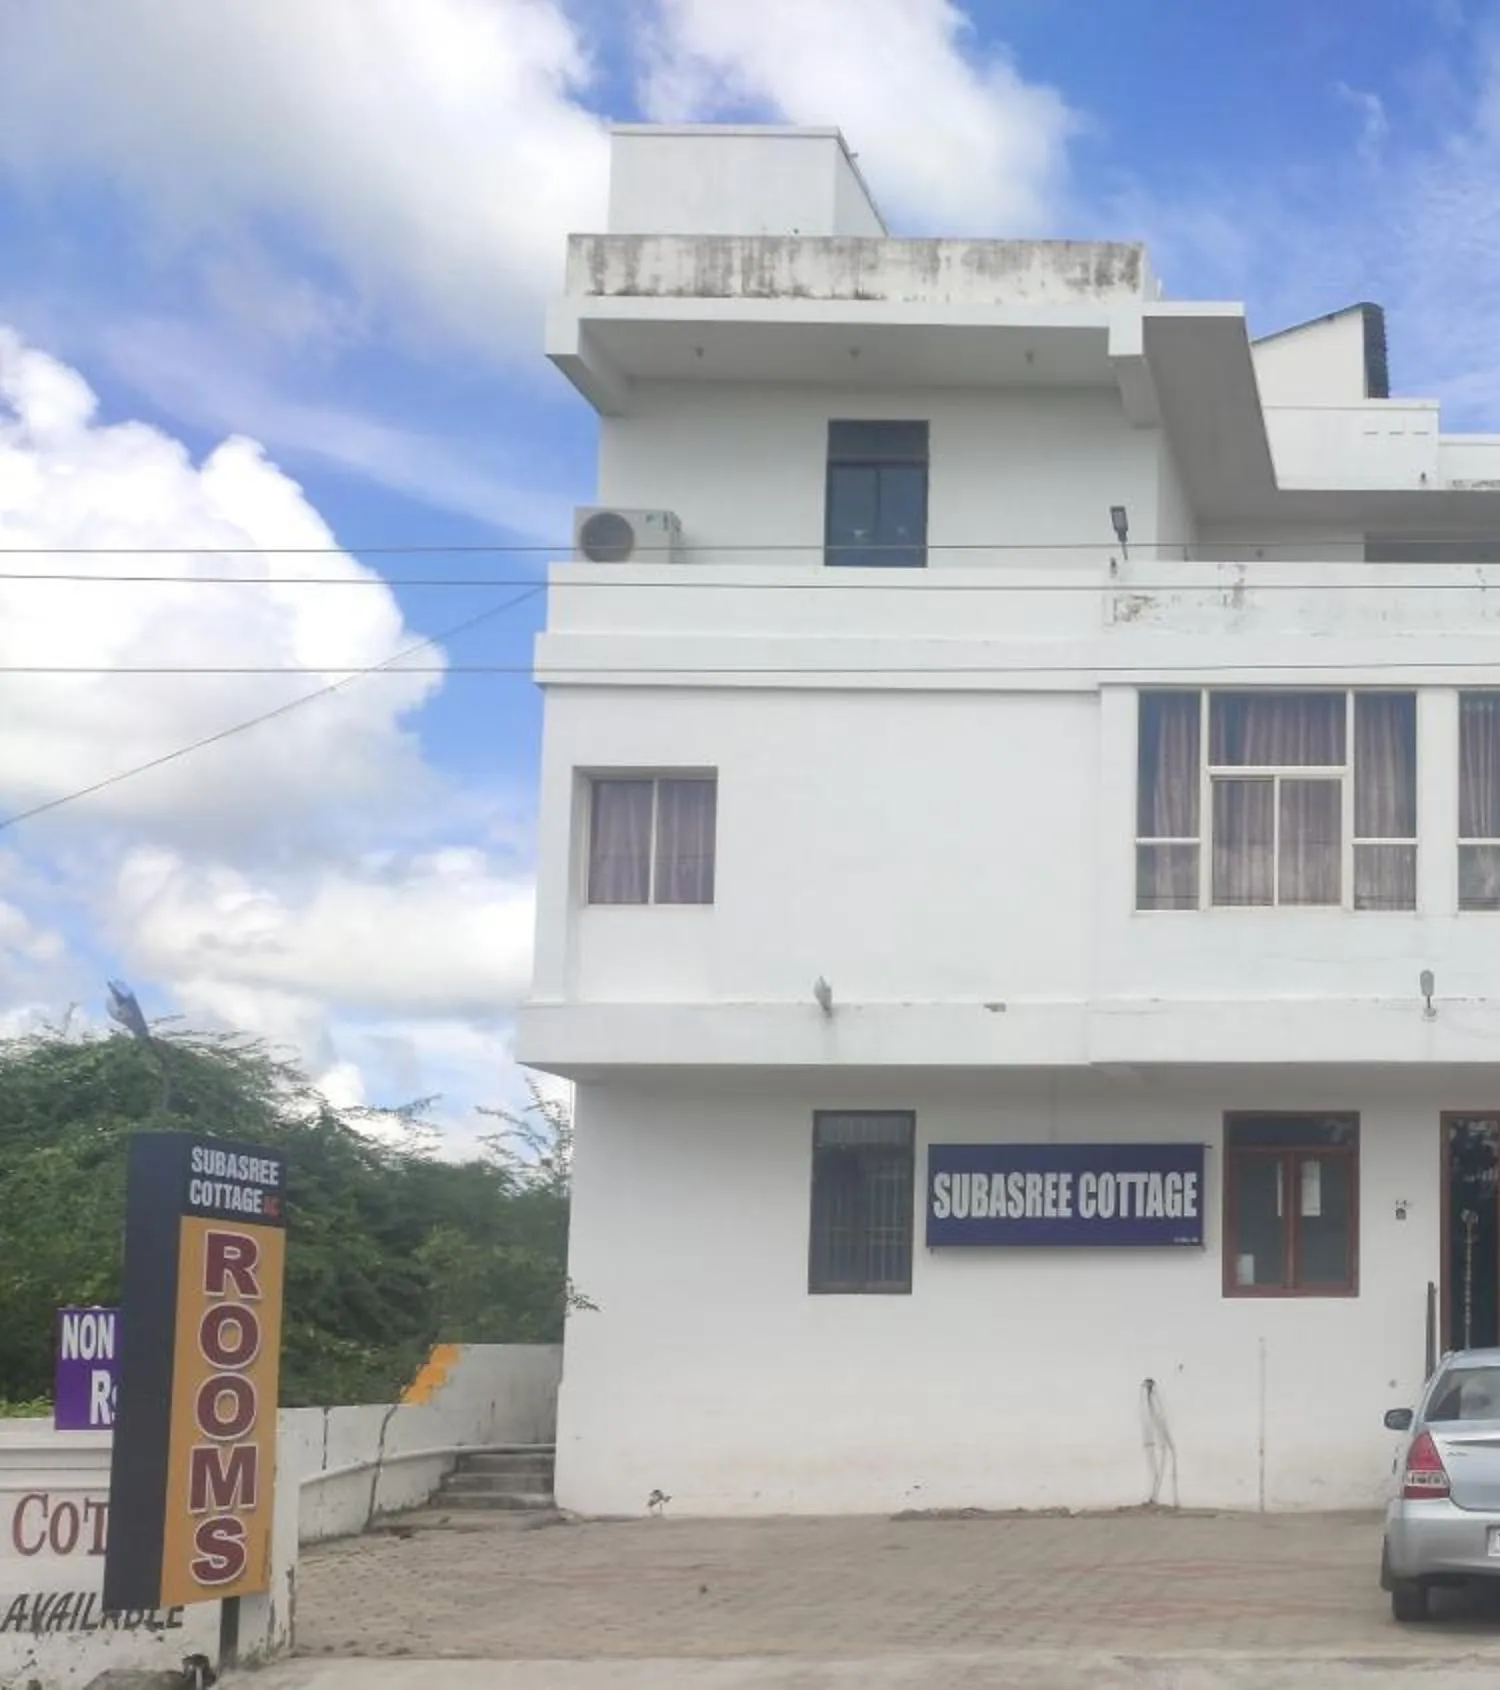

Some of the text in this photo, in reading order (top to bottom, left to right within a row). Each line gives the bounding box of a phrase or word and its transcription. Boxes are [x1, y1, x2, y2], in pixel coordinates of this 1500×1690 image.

[191, 1146, 279, 1185] SUBASREE
[190, 1179, 263, 1213] COTTAGE
[933, 1171, 1198, 1219] SUBASREE COTTAGE
[61, 1313, 116, 1361] NON
[187, 1229, 262, 1587] ROOMS
